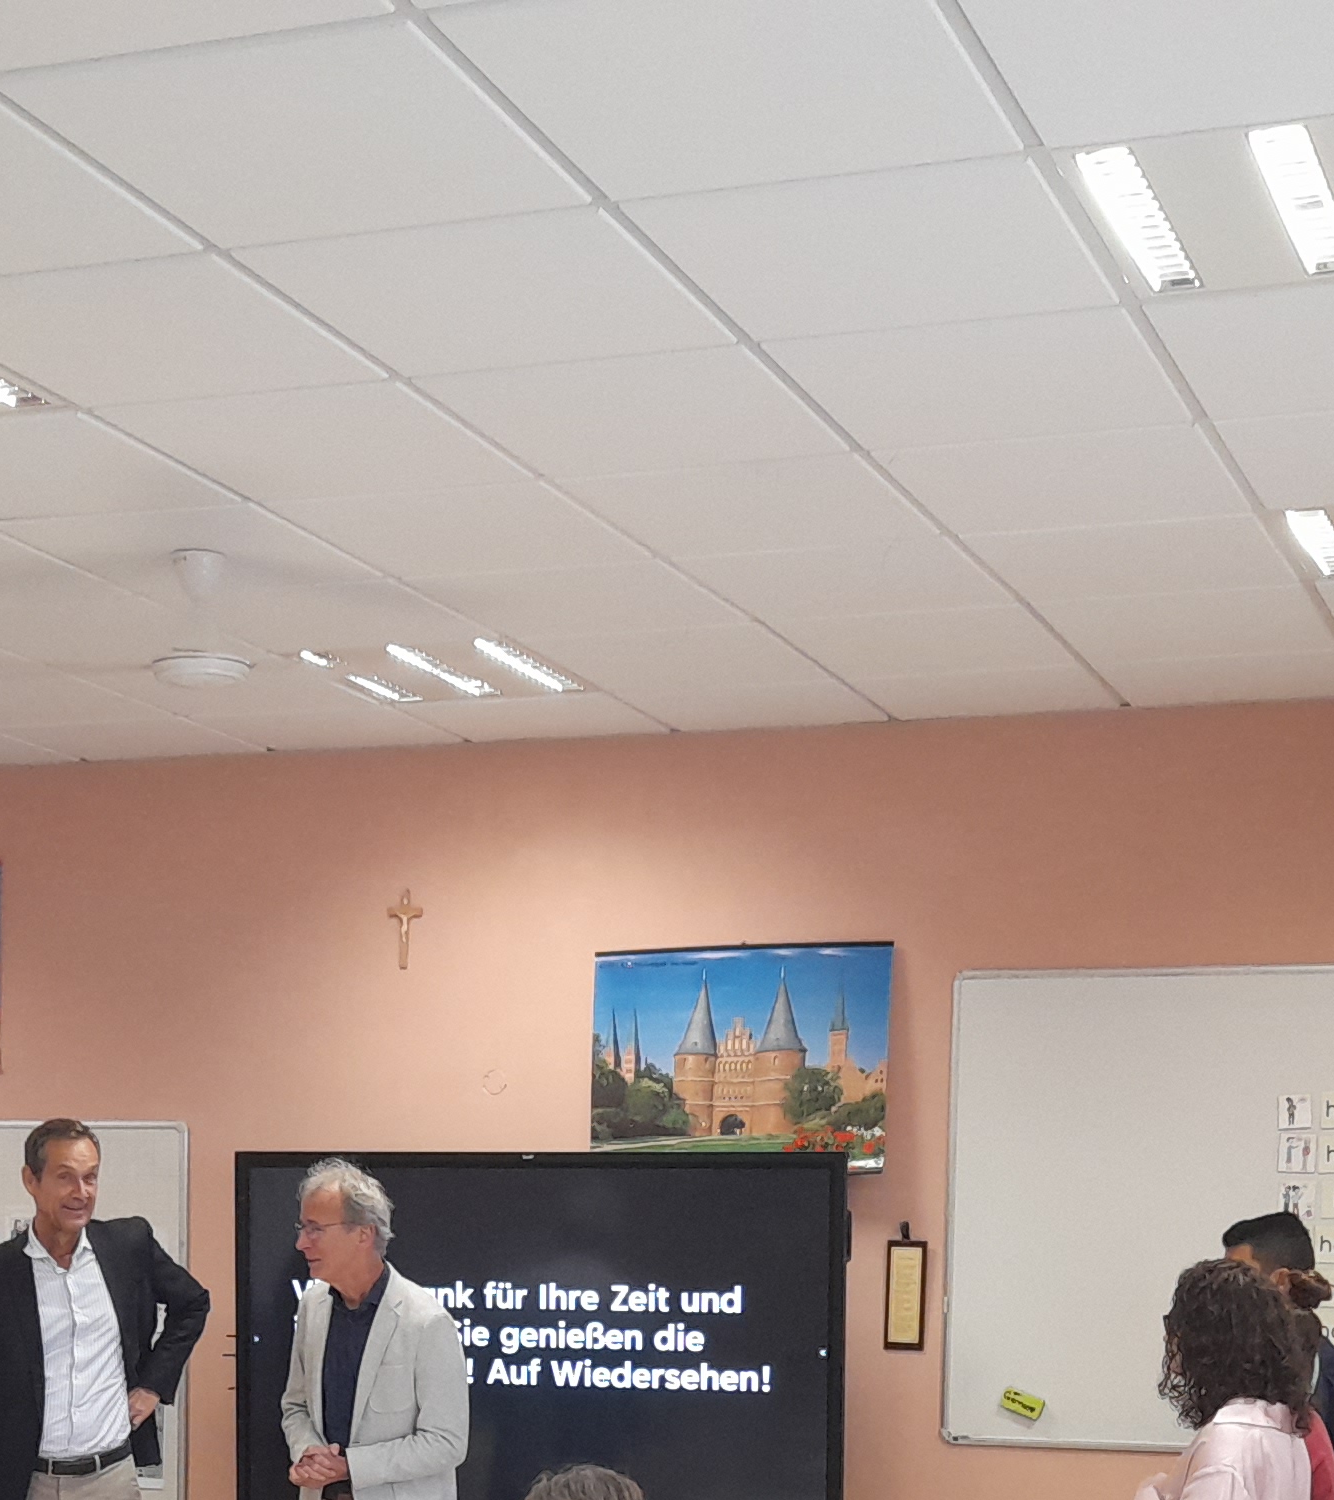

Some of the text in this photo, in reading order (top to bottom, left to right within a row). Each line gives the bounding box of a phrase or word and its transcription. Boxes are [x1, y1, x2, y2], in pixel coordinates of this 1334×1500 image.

[483, 1280, 528, 1310] für
[539, 1282, 600, 1311] Ihre
[610, 1283, 670, 1313] Zeit
[680, 1284, 742, 1314] und
[499, 1320, 643, 1354] genießen
[653, 1322, 705, 1352] die
[486, 1358, 542, 1386] Auf
[551, 1359, 772, 1393] Wiedersehen!
